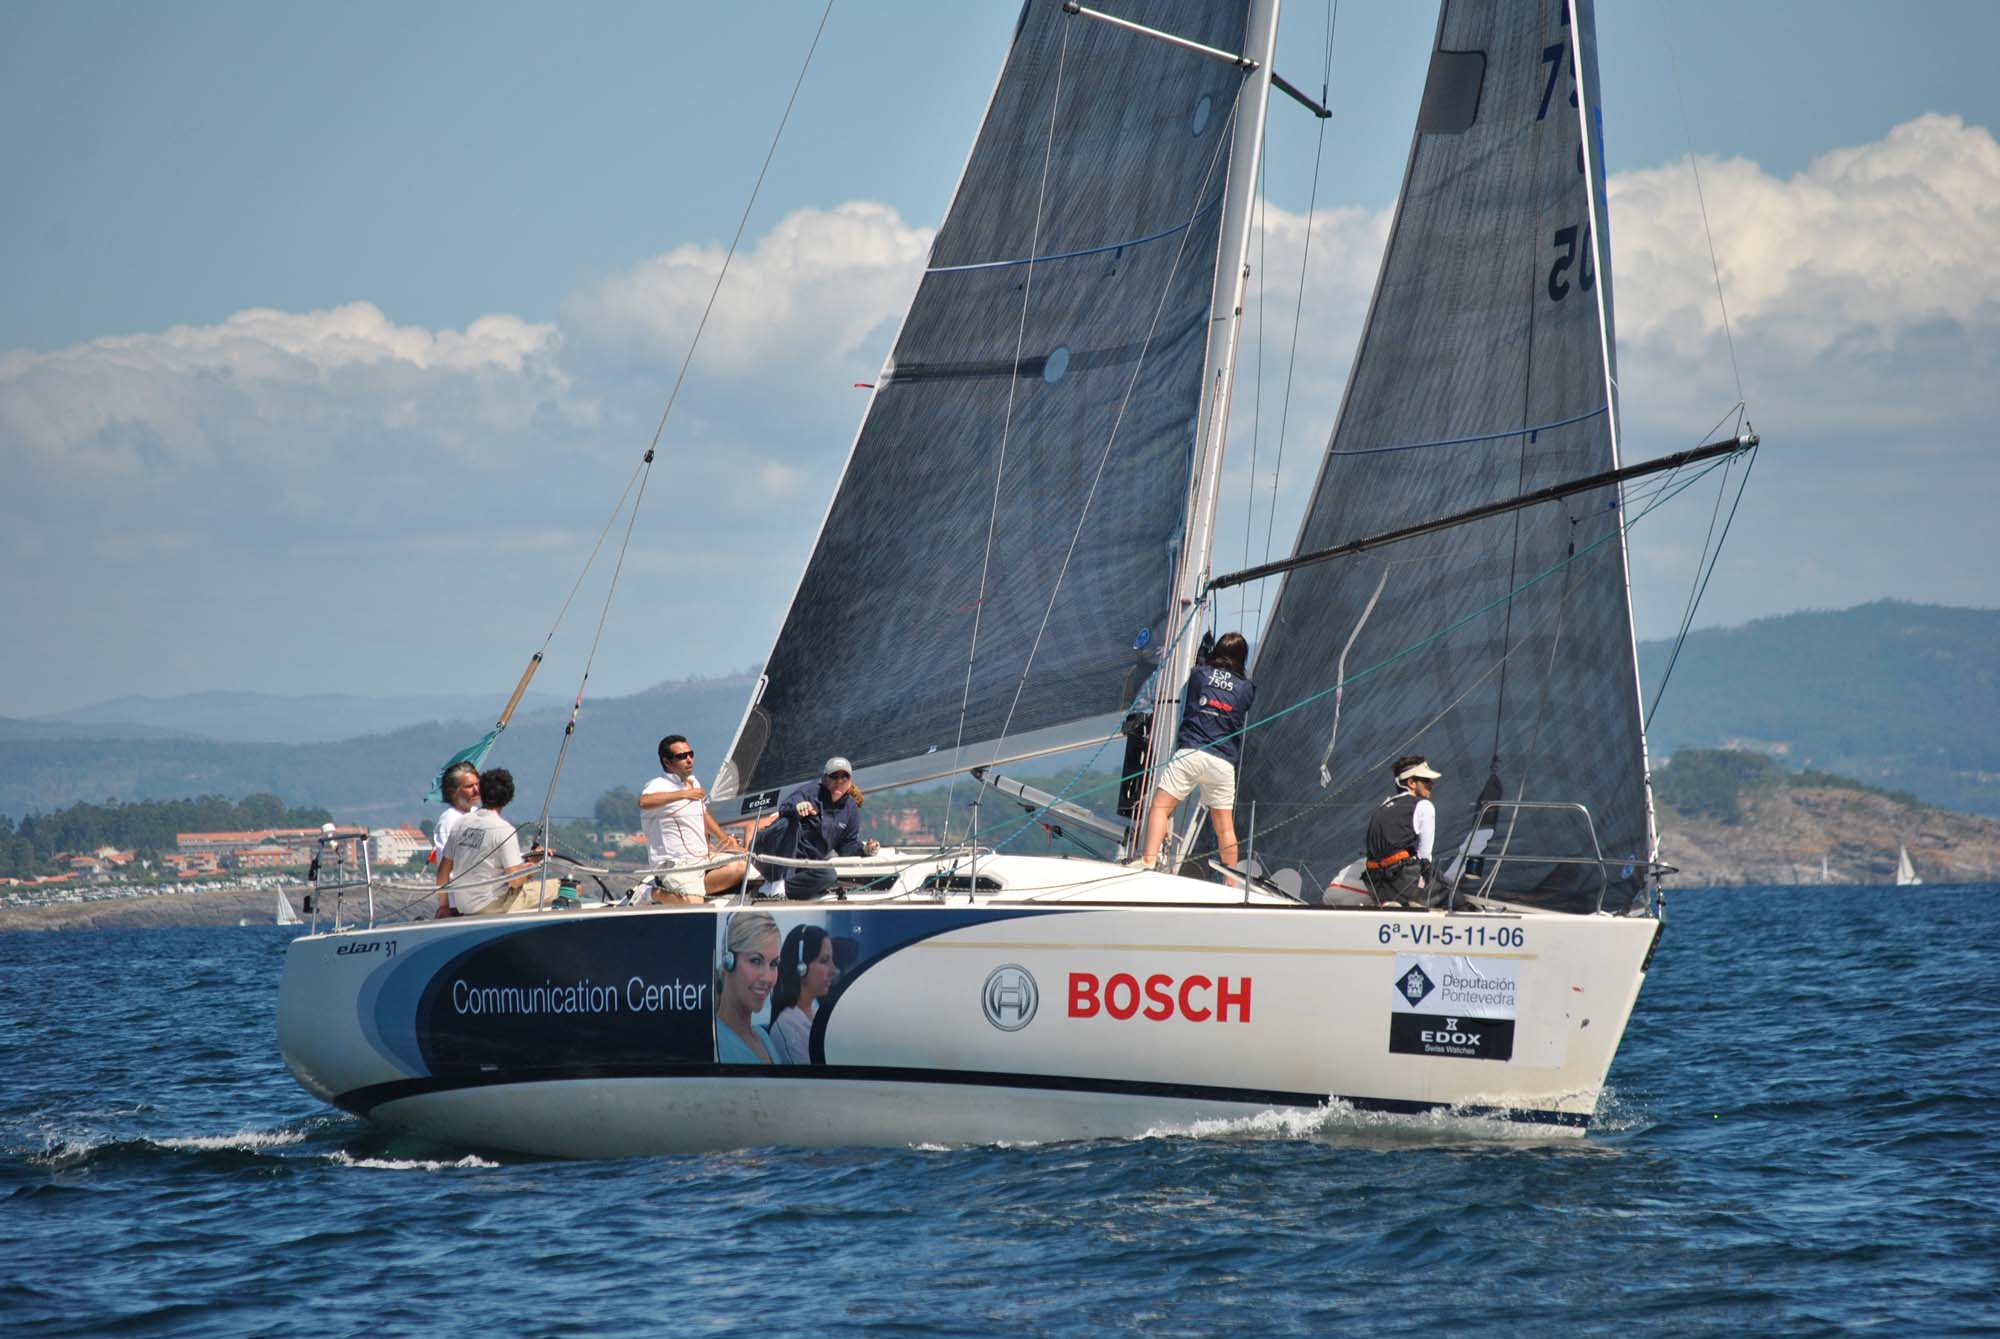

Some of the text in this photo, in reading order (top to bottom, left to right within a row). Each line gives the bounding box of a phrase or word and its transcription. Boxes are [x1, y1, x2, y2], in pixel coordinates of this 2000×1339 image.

[1208, 675, 1234, 691] 7505
[1212, 669, 1231, 681] ESP
[336, 940, 397, 957] elan 37
[1442, 974, 1516, 992] Deputación
[452, 976, 707, 1016] Communication Center
[1067, 972, 1252, 1023] BOSCH
[1441, 989, 1515, 1006] Pontevedra
[1420, 1030, 1481, 1046] EDOX
